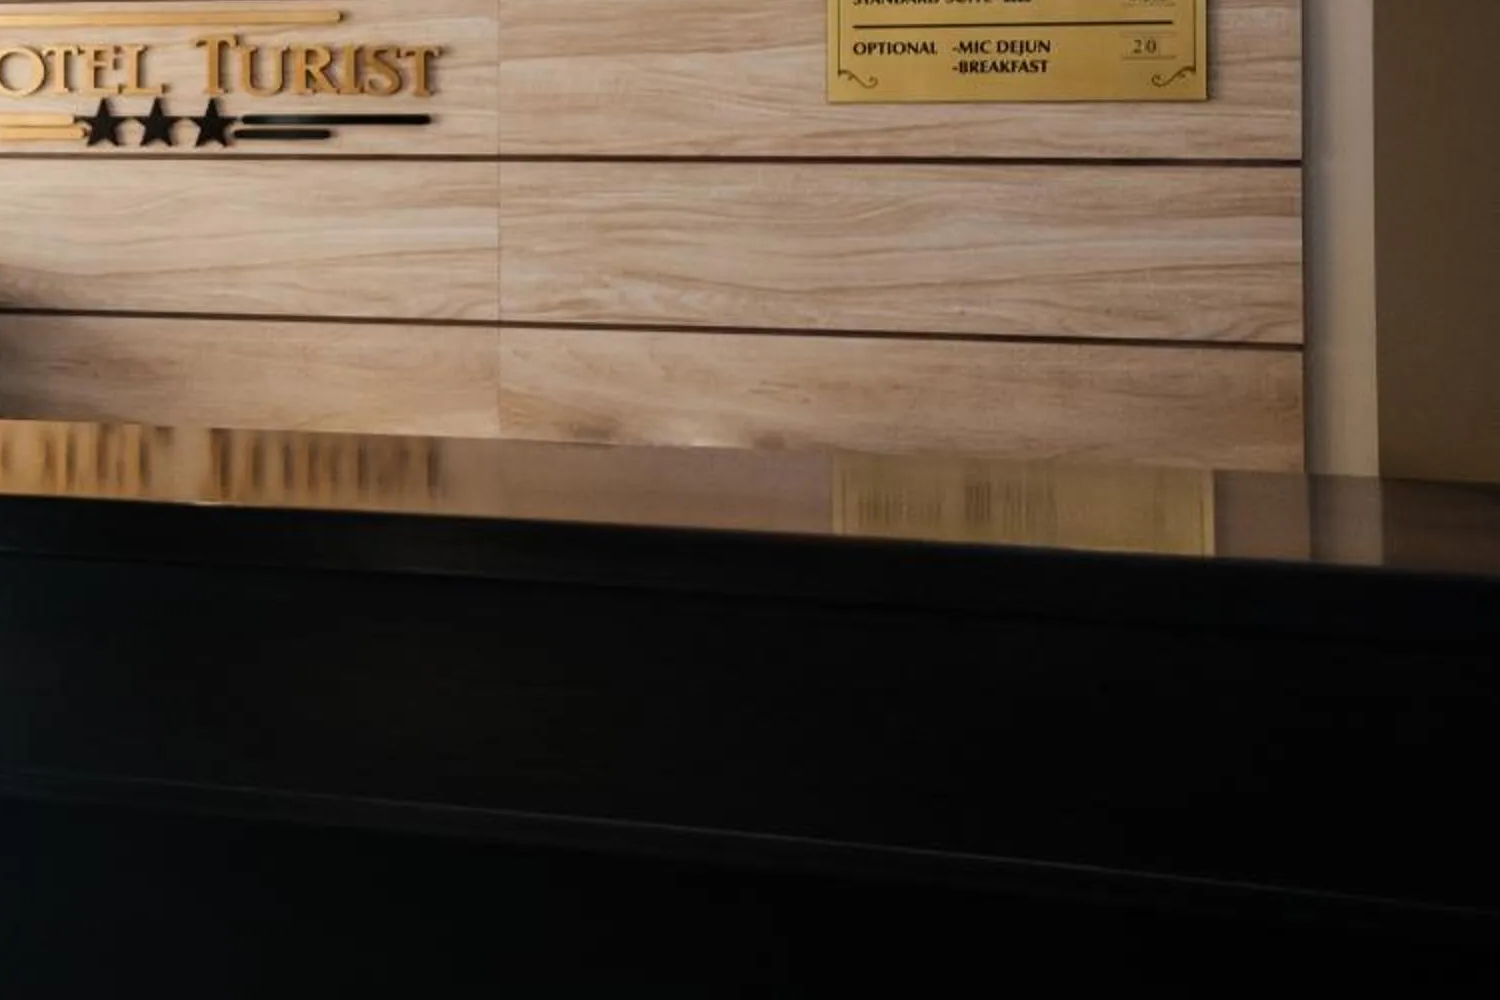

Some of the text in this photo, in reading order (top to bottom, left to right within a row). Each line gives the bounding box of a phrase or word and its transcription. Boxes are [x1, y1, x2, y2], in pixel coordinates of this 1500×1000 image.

[852, 41, 938, 56] OPTIONAL
[996, 38, 1051, 54] DEJUN
[1132, 38, 1158, 54] 20
